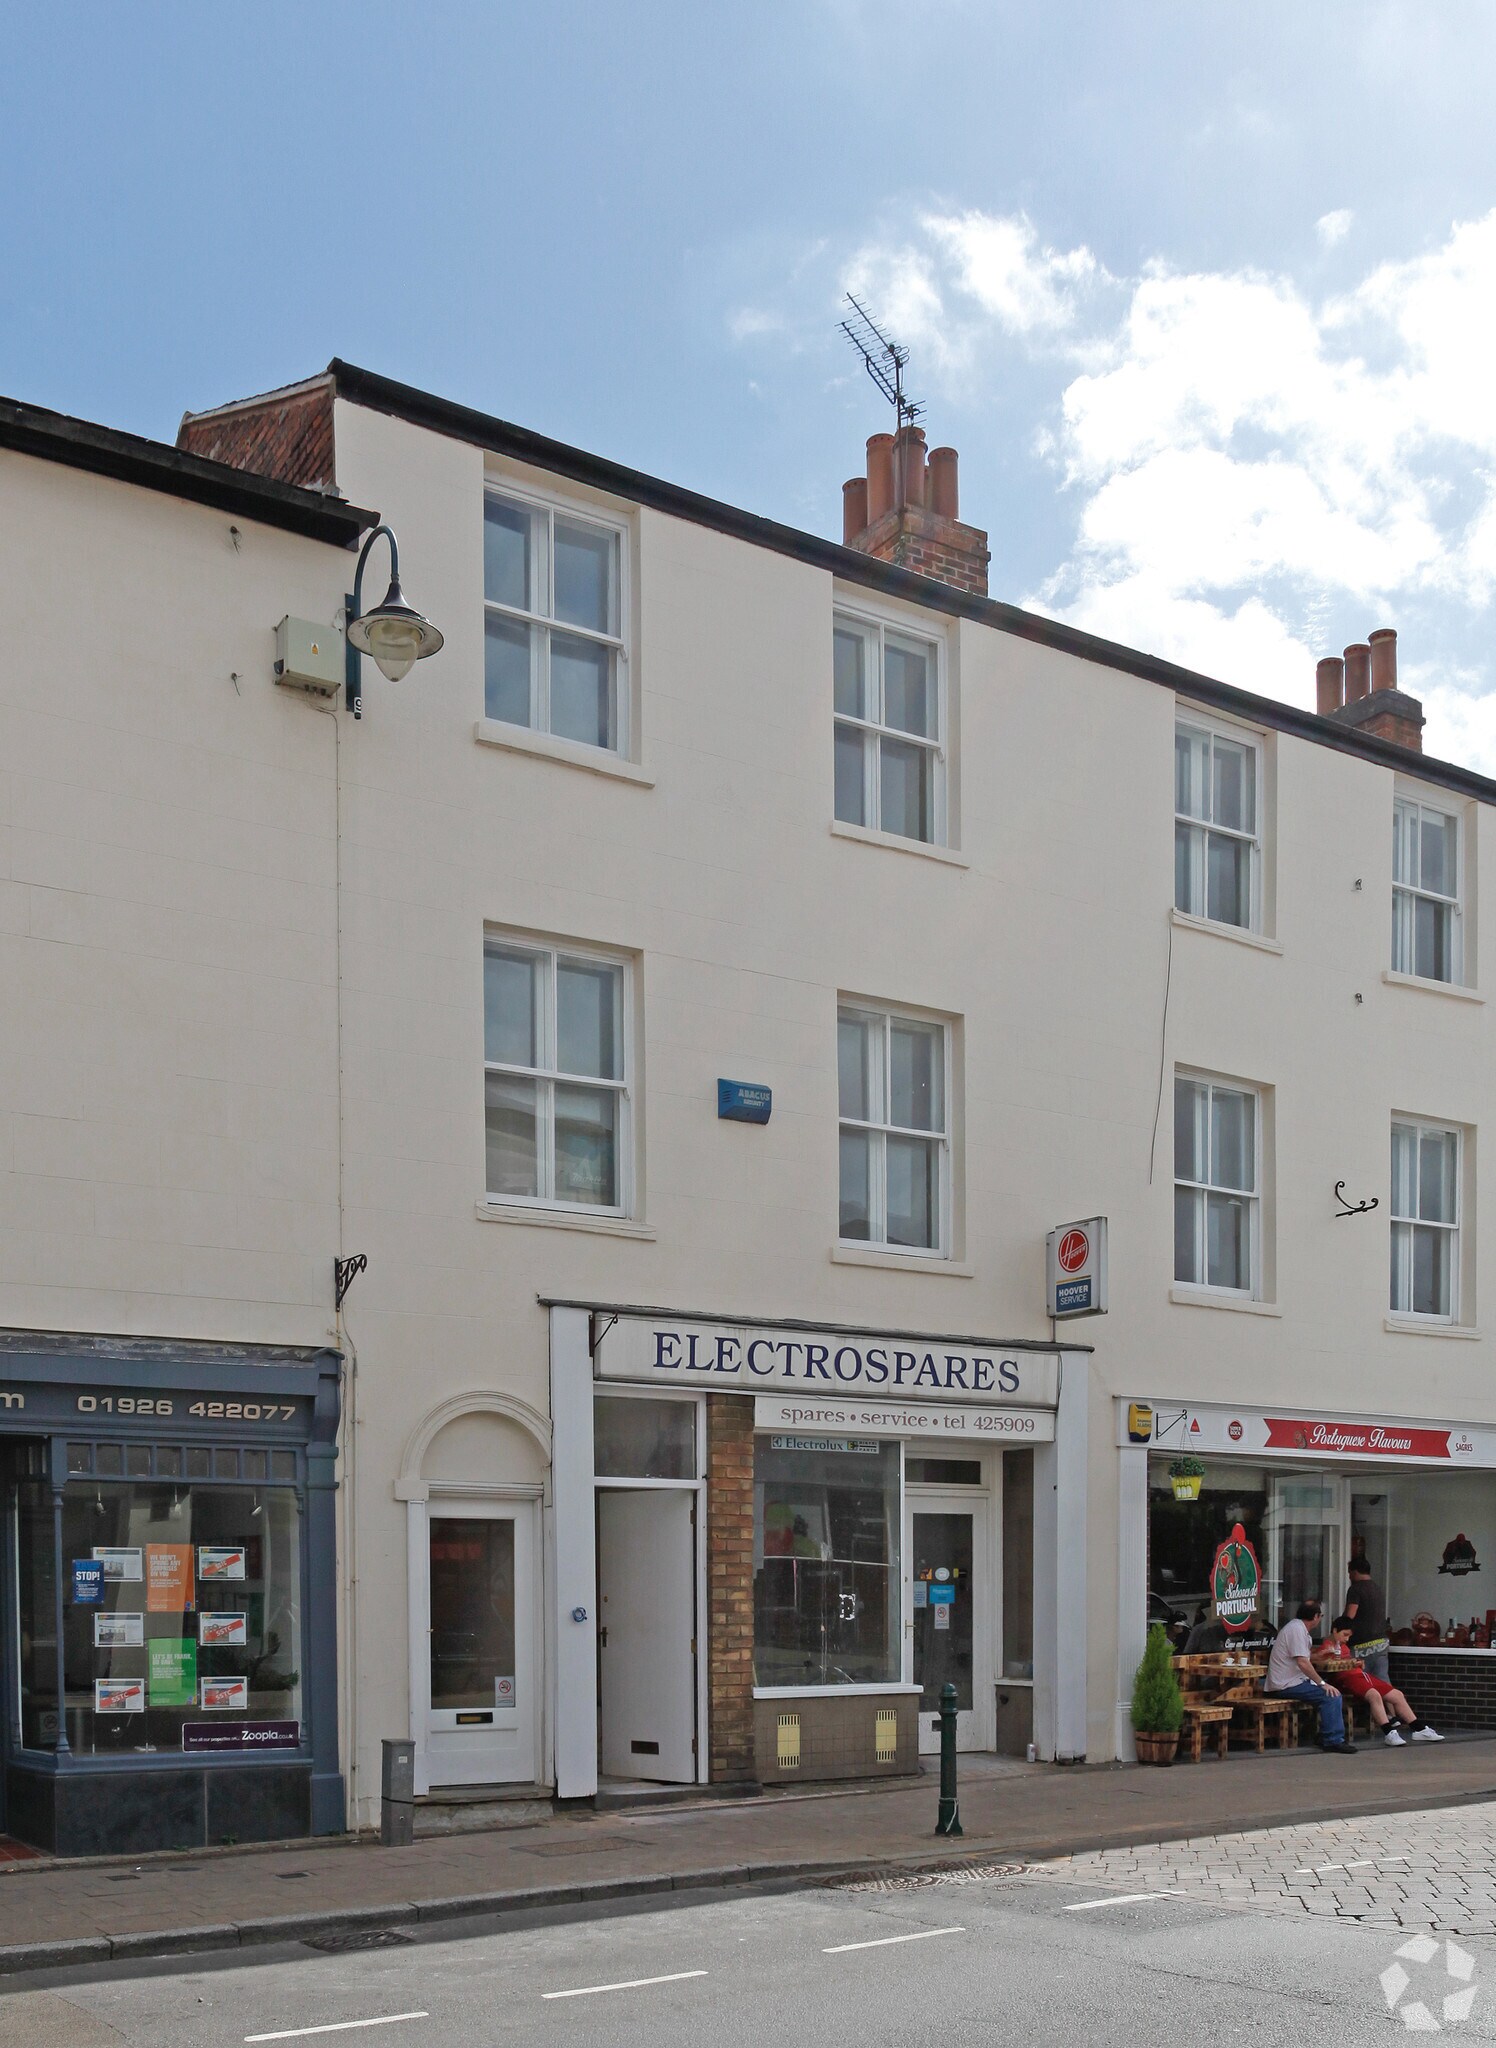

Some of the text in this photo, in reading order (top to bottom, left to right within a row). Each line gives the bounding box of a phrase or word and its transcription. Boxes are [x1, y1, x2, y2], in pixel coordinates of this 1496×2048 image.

[738, 1088, 770, 1101] ABACUS
[1058, 1284, 1089, 1297] HOOVER
[1060, 1293, 1087, 1306] SERVICE
[652, 1331, 1020, 1393] ELECTROSPARES
[77, 1396, 173, 1415] 01926
[188, 1401, 296, 1421] 422077
[780, 1408, 1035, 1433] spares service tel 425909
[786, 1437, 843, 1450] Electrolux
[1309, 1424, 1412, 1451] Portuguese Flavours
[76, 1571, 100, 1580] STOP!
[1216, 1598, 1257, 1616] PORTUGAL
[216, 1625, 232, 1636] SSTC
[111, 1691, 128, 1703] SSTC
[215, 1690, 232, 1701] SSTC
